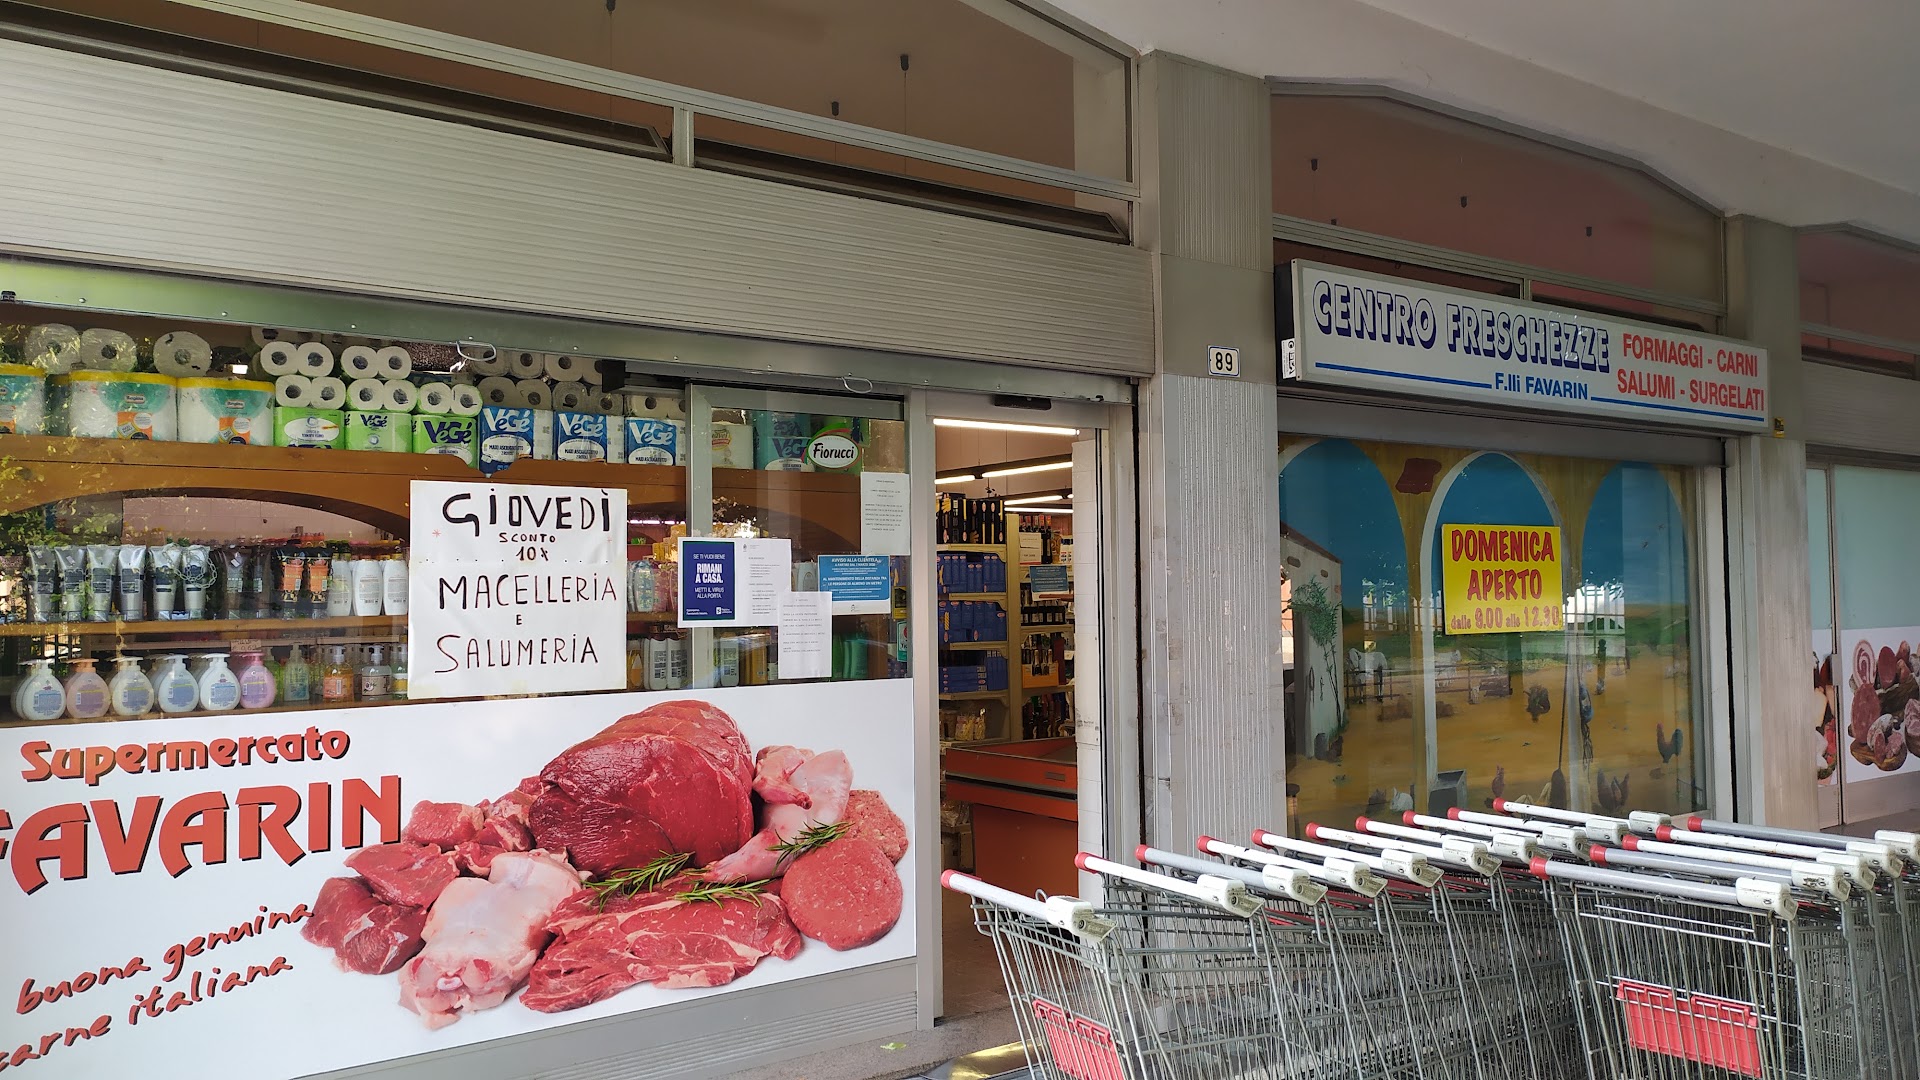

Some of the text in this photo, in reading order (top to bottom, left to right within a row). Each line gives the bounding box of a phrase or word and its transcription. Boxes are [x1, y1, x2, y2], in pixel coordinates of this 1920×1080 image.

[1312, 280, 1610, 373] CENTRO FRESCHEZZE
[1215, 351, 1233, 372] 89
[1623, 333, 1703, 368] FORMAGGI
[1717, 349, 1758, 377] CARNI
[1495, 372, 1588, 400] F.lli FAVARIN
[1617, 368, 1675, 400] SALUMI
[1689, 379, 1765, 411] SURGELATI
[813, 442, 854, 459] Fiorucci
[499, 532, 556, 543] SCONTO
[1451, 529, 1555, 562] DOMENICA
[695, 574, 701, 583] A
[696, 563, 722, 573] RIMANI
[439, 573, 617, 610] MACELLERIA
[1467, 569, 1542, 601] APERTO
[516, 614, 523, 626] E
[1451, 614, 1472, 630] dalle
[1506, 613, 1521, 628] alle
[1523, 605, 1560, 627] 12.30
[434, 634, 598, 674] SALUMERIA
[20, 726, 351, 786] Supermercato
[0, 775, 401, 894] AVARIN
[16, 903, 314, 1015] buona genuina
[128, 953, 293, 1026] italiana
